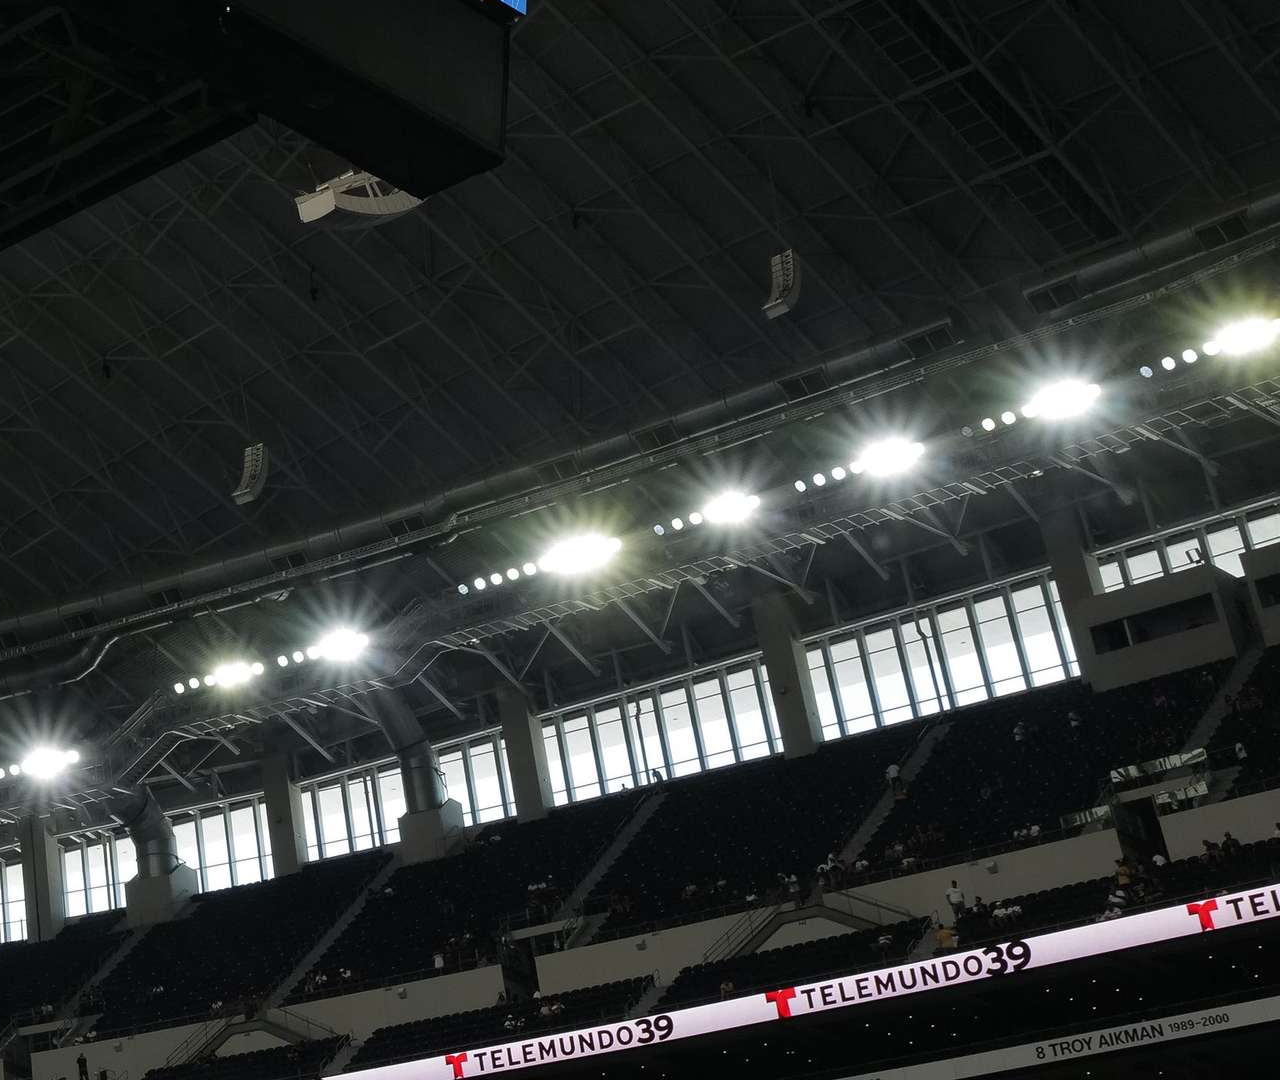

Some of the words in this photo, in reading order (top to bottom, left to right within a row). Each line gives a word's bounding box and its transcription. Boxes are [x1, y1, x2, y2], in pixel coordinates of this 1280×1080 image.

[1035, 1045, 1047, 1061] 8
[1048, 1036, 1094, 1059] TROY
[1098, 1024, 1165, 1050] AIKMAN
[1167, 1012, 1231, 1034] 1989-2000
